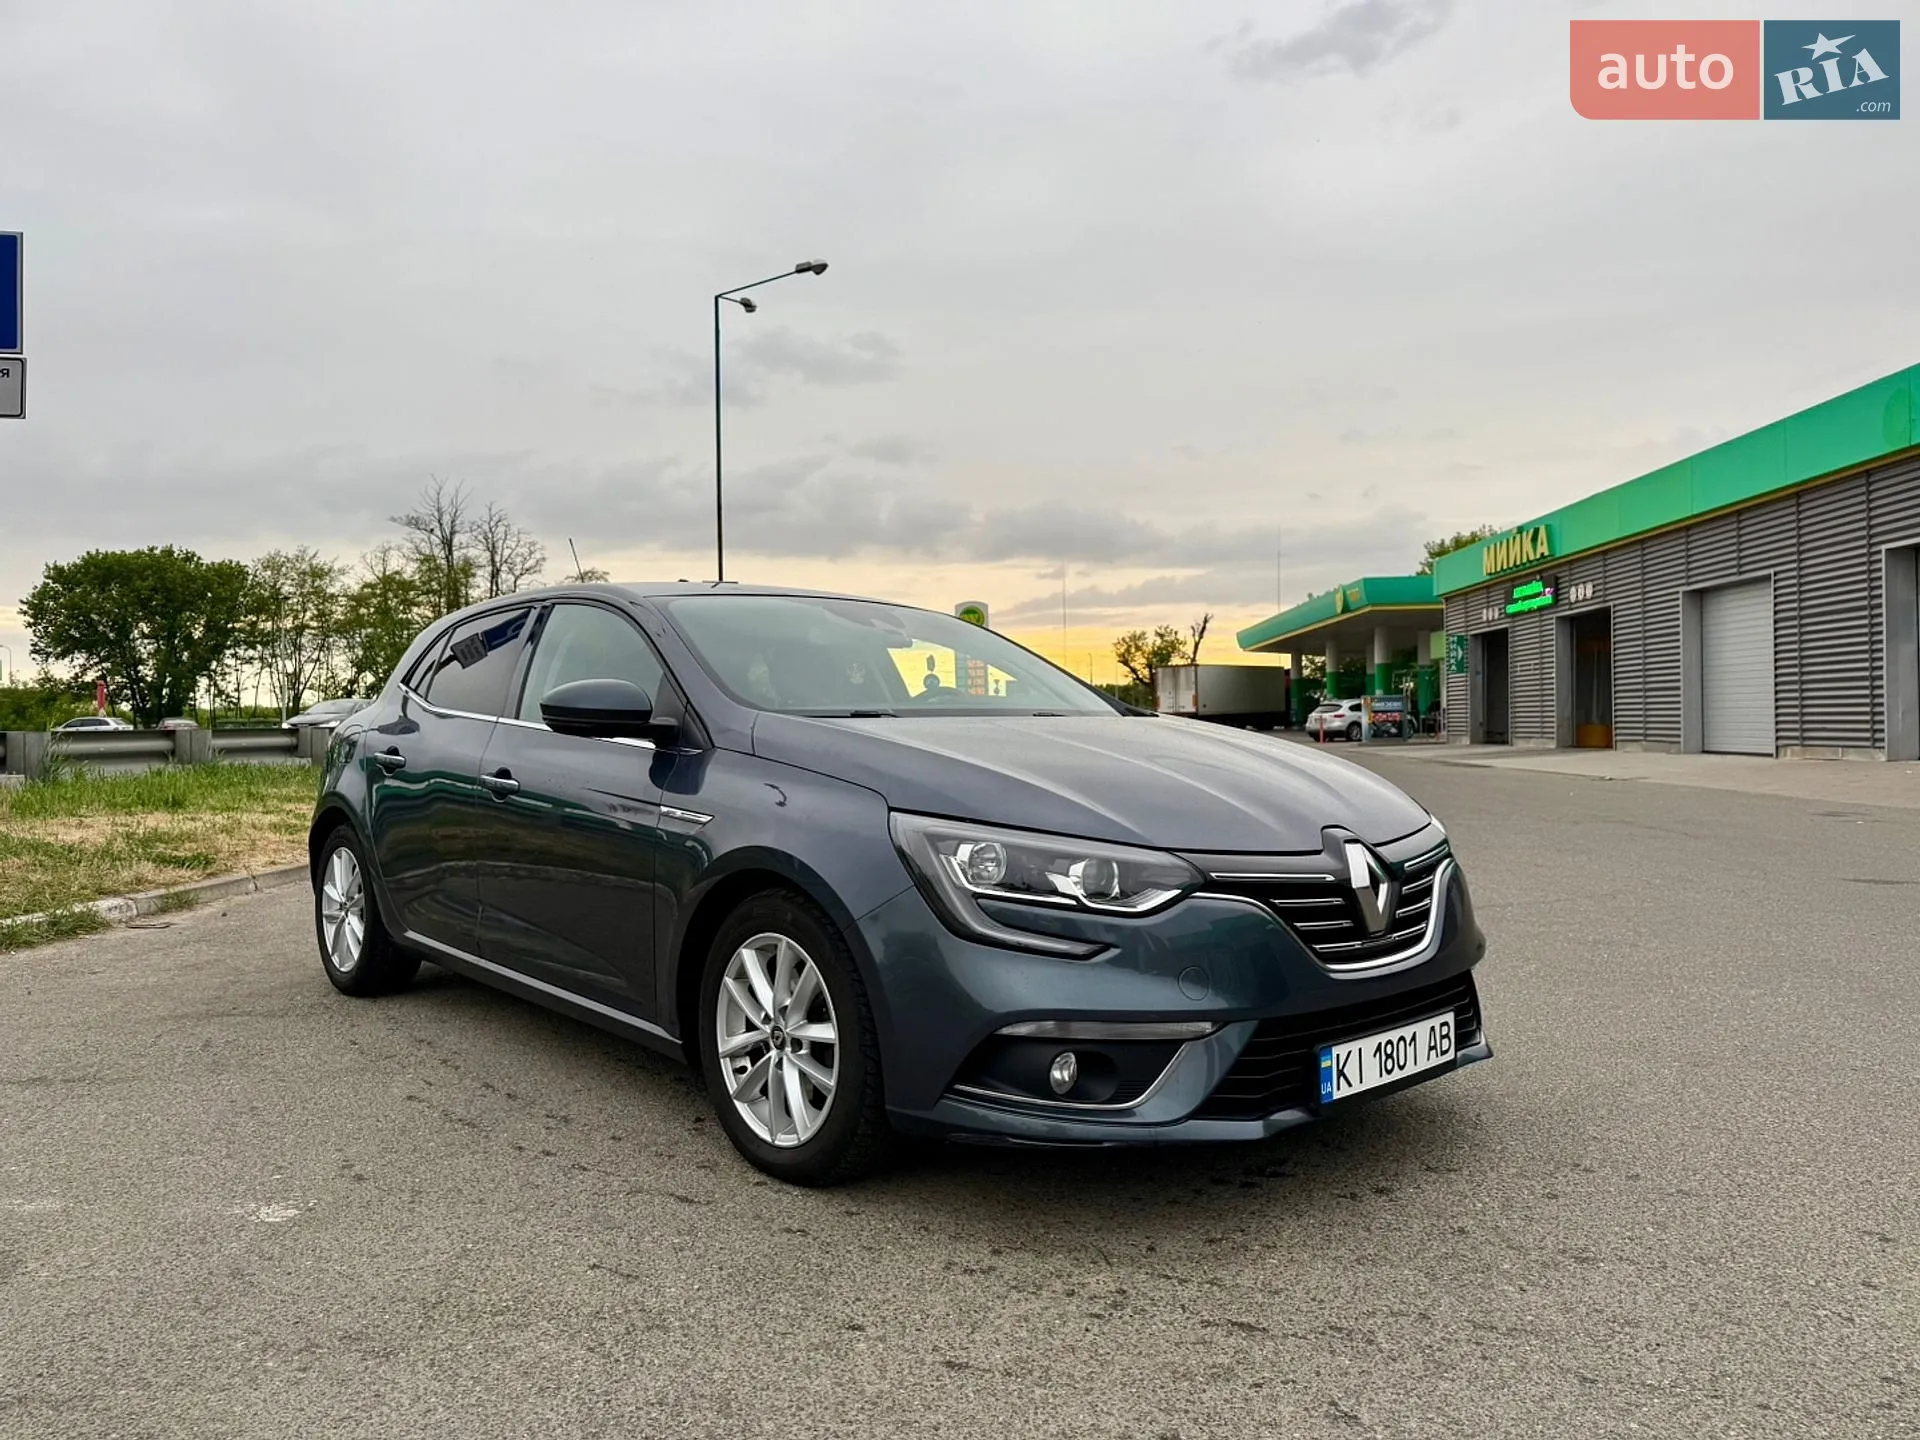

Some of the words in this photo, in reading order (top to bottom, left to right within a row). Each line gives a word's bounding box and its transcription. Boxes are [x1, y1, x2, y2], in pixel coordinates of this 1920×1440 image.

[1483, 525, 1548, 576] МИЙКА
[1335, 1046, 1363, 1091] KI
[1373, 1031, 1418, 1078] 1801
[1426, 1020, 1453, 1062] AB
[1321, 1083, 1332, 1095] UA
